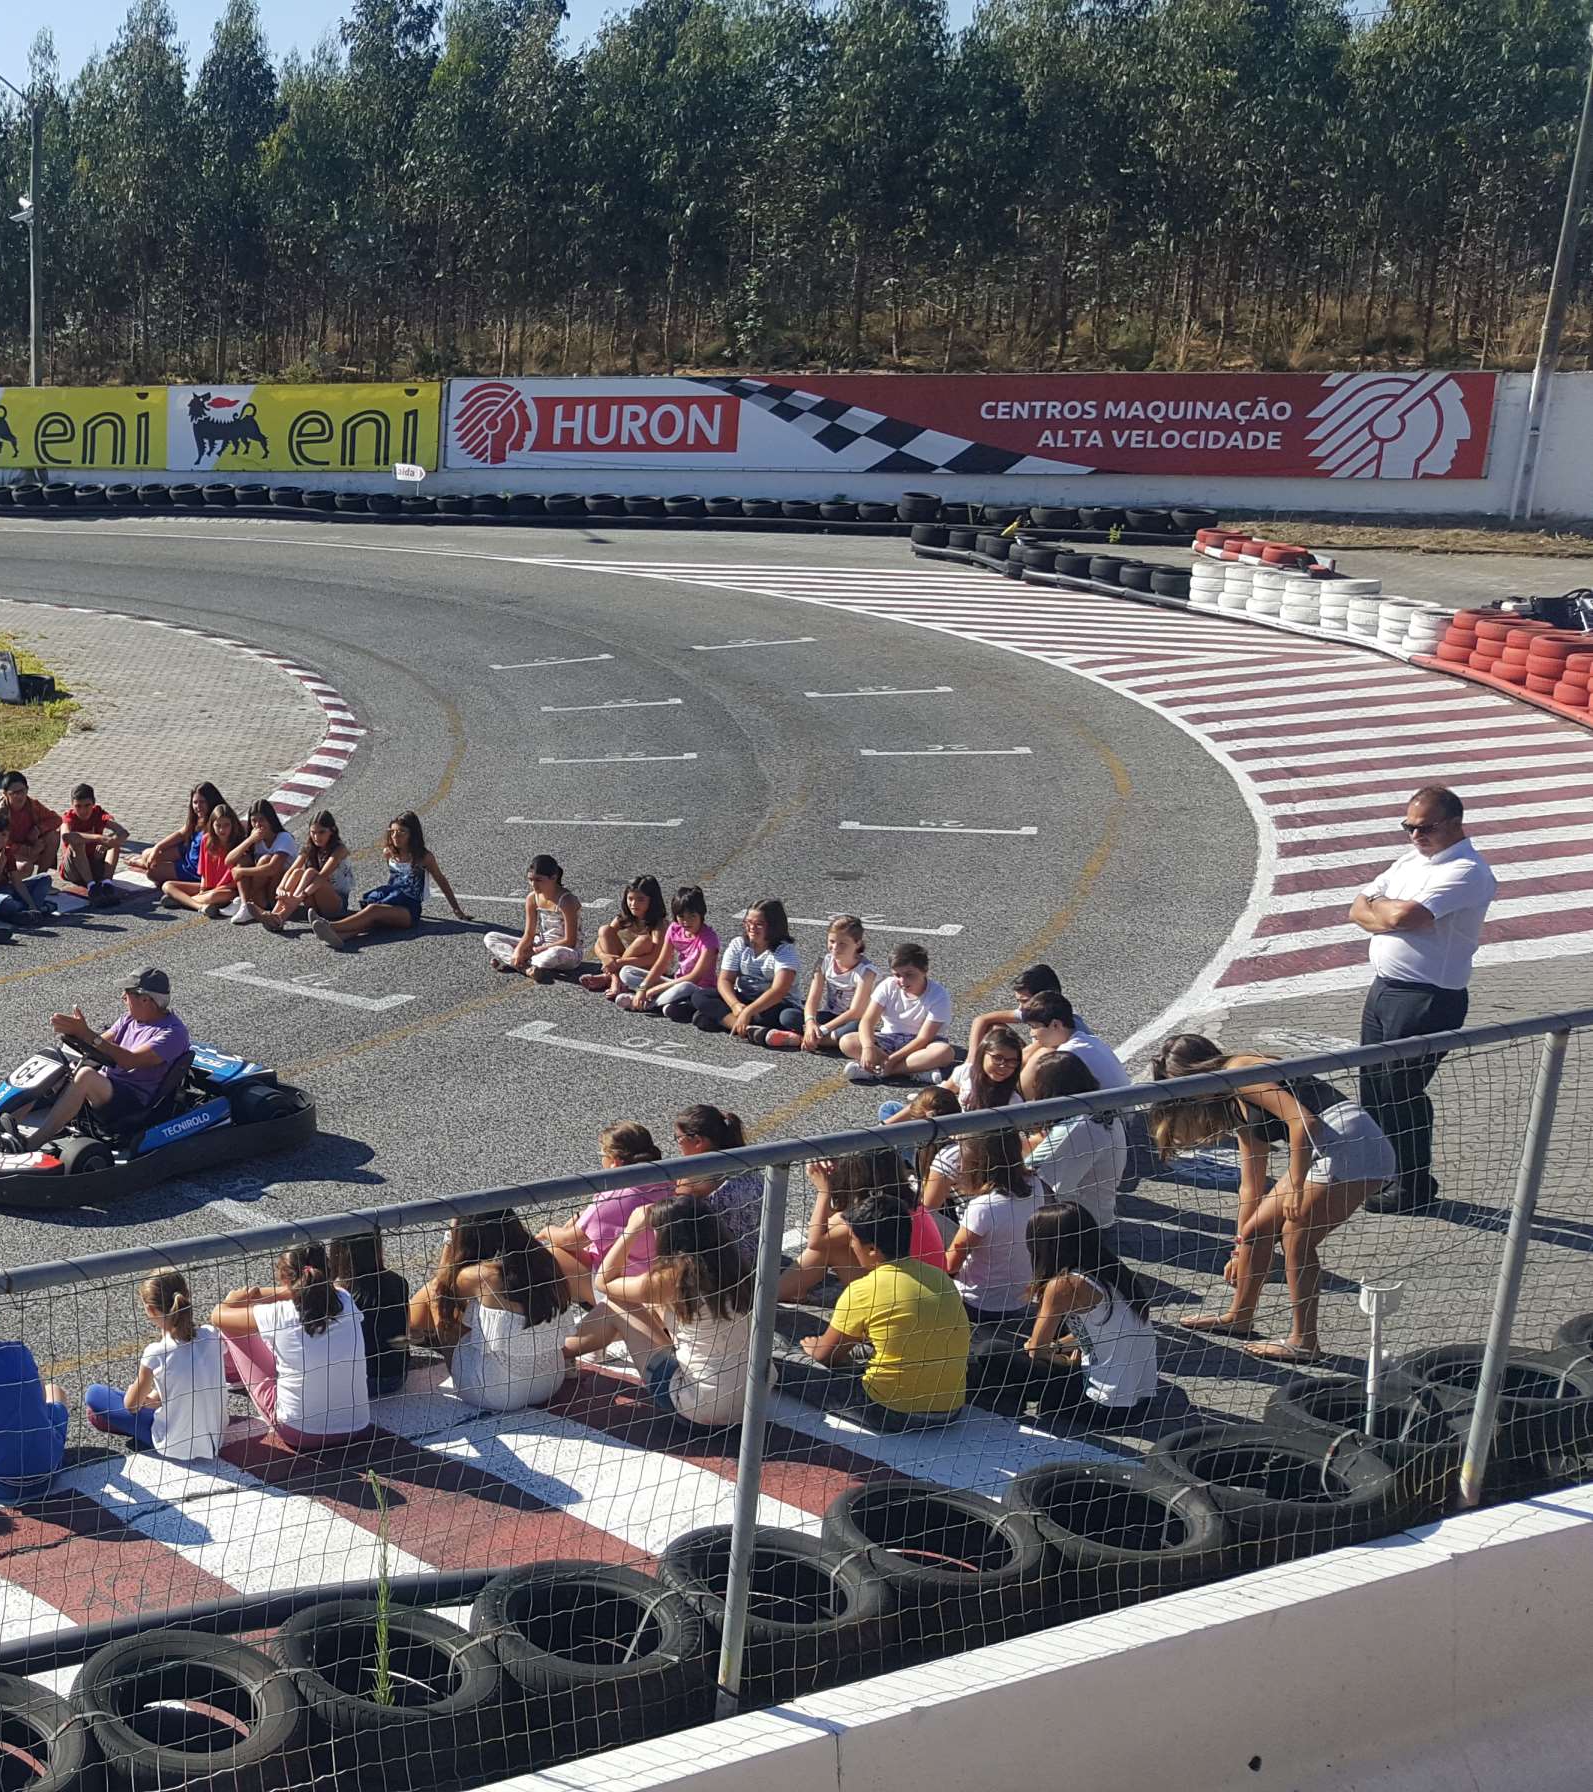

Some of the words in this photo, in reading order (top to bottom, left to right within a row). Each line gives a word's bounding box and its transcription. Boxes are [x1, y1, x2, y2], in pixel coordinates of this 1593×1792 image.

[980, 400, 1097, 420] CENTROS
[1104, 396, 1293, 425] MAQUINAÇÃO
[34, 392, 150, 465] eni
[288, 388, 419, 466] eni
[552, 403, 722, 446] HURON
[1037, 430, 1104, 448] ALTA
[1112, 430, 1282, 449] VELOCIDADE
[622, 1036, 689, 1054] 20
[15, 1060, 48, 1083] 64
[161, 1112, 210, 1137] TECNIROLO
